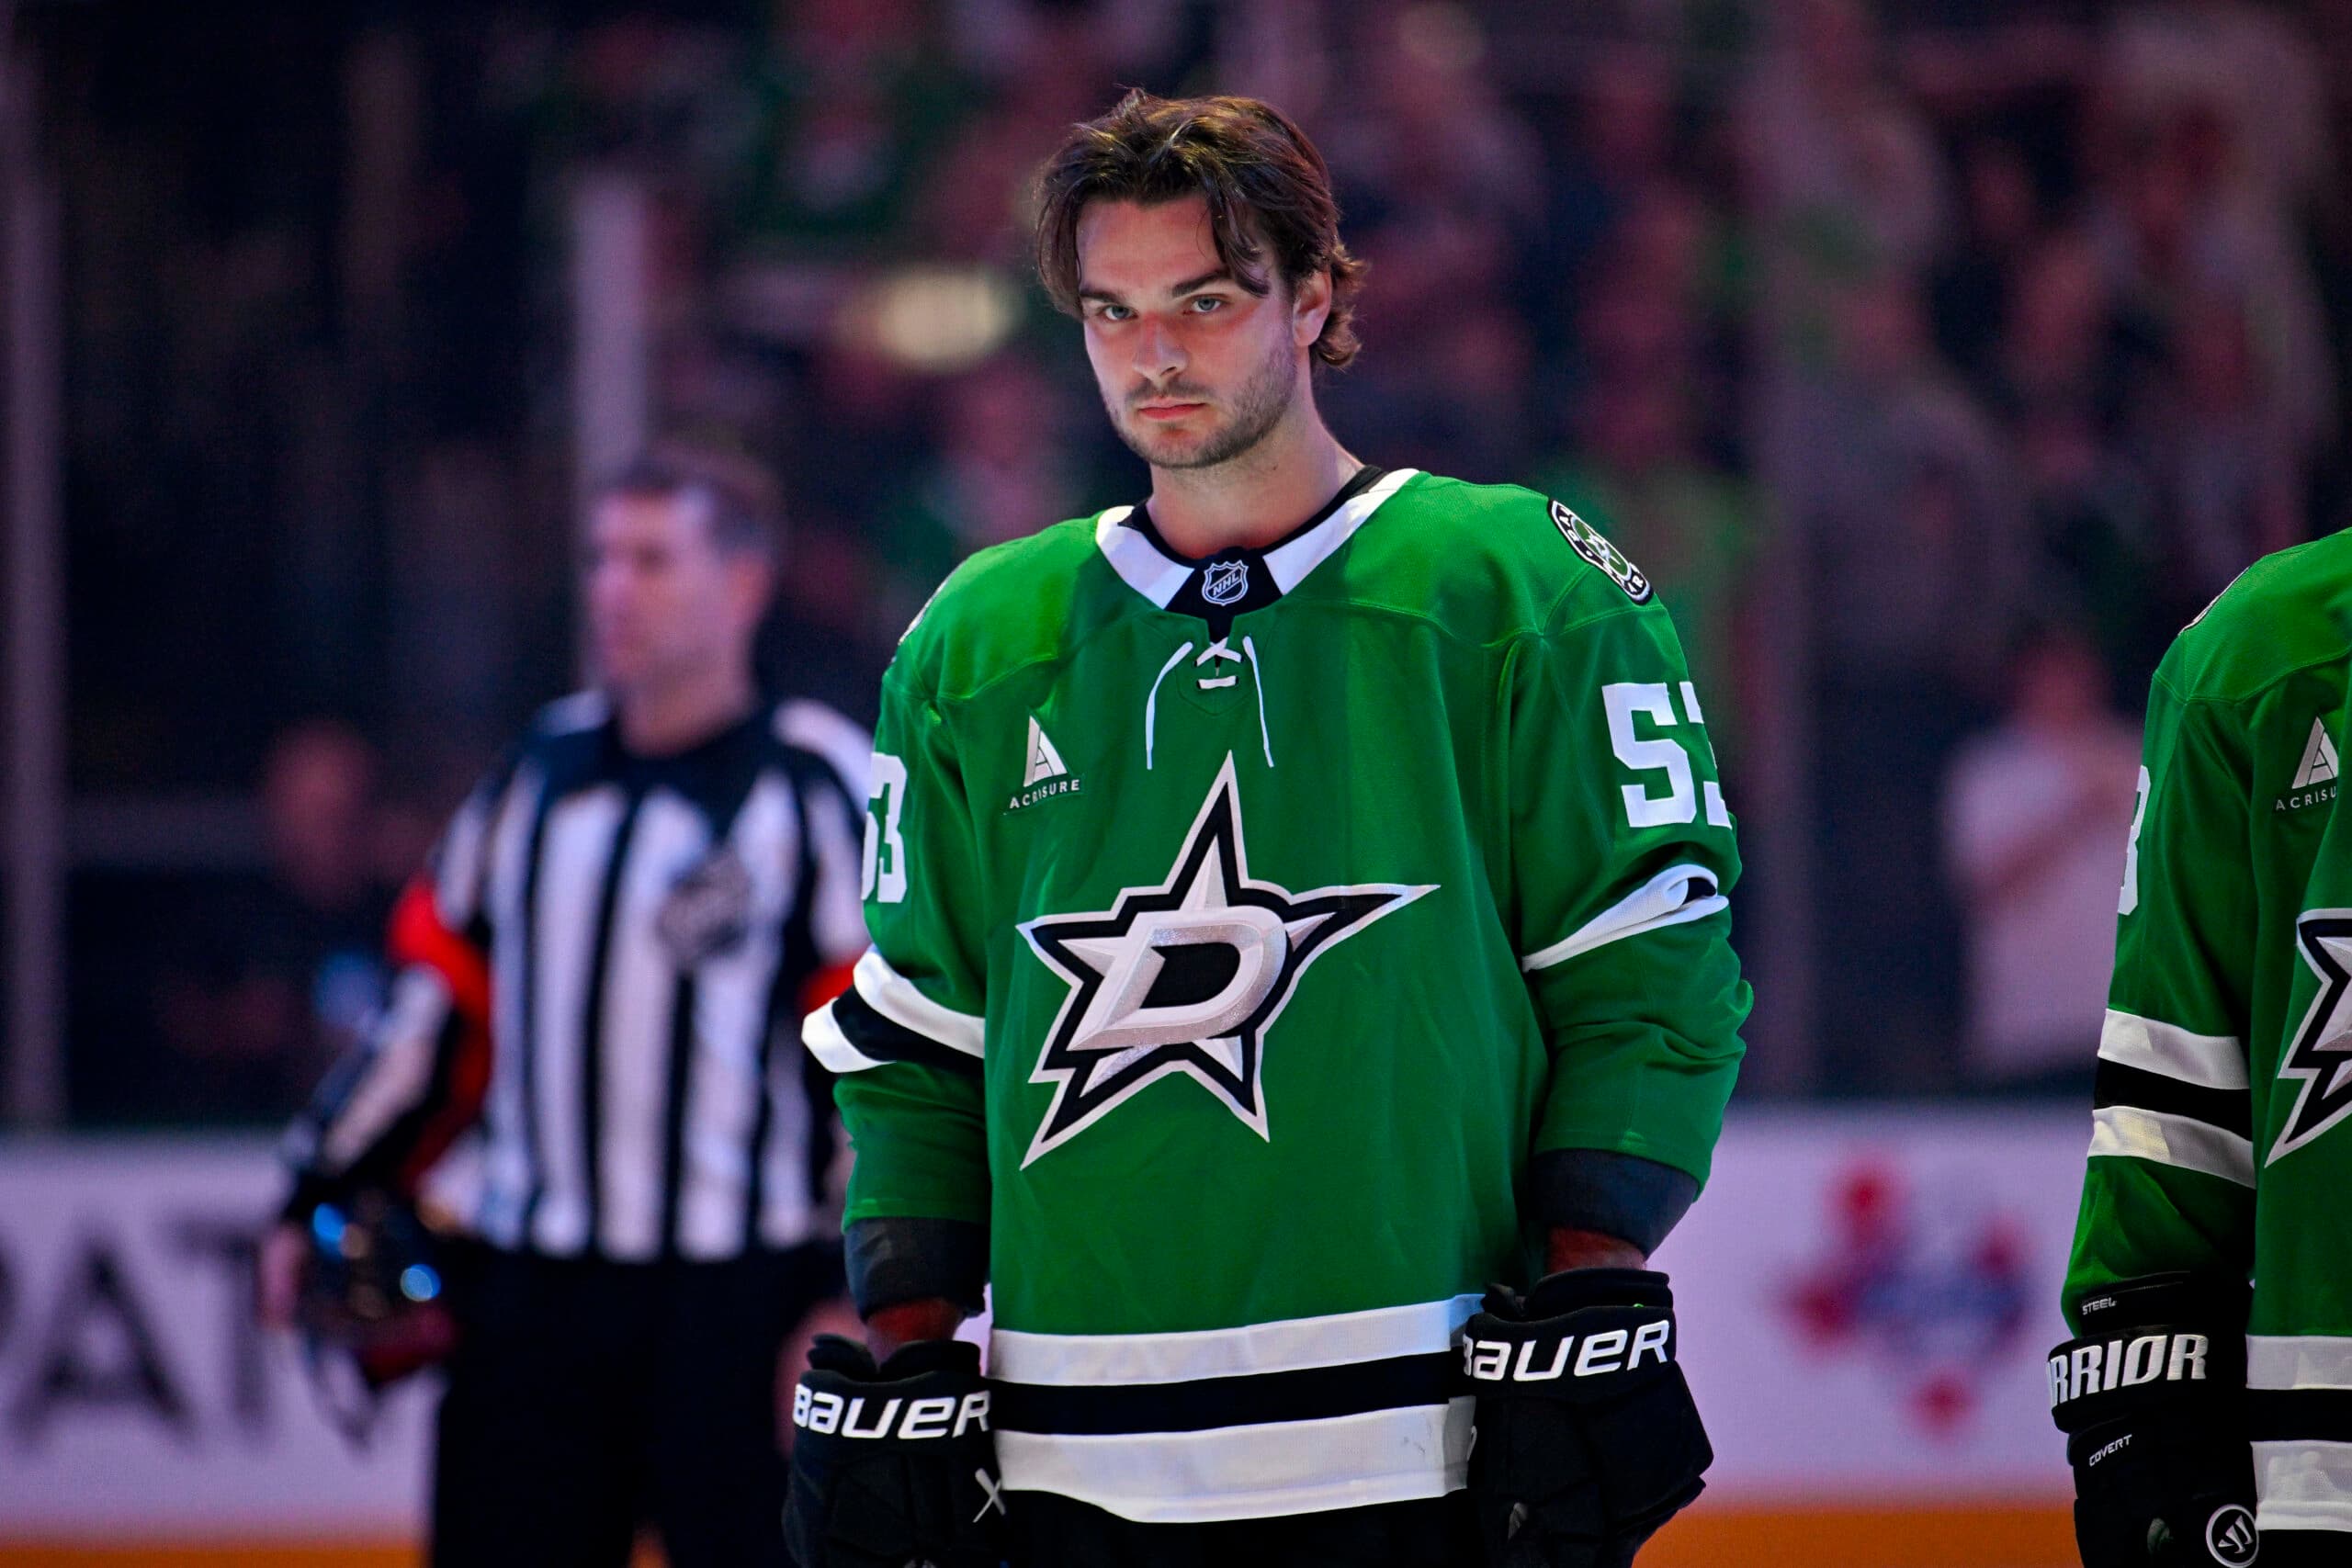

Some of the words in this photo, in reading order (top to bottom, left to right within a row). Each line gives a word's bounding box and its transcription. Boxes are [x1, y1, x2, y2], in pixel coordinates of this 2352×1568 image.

[1213, 572, 1239, 596] NHL
[1009, 779, 1080, 809] ACRISURE
[2082, 1296, 2118, 1315] STEEL
[0, 1211, 268, 1451] AT
[2047, 1333, 2210, 1408] RRIOR
[2088, 1434, 2132, 1467] COVERT
